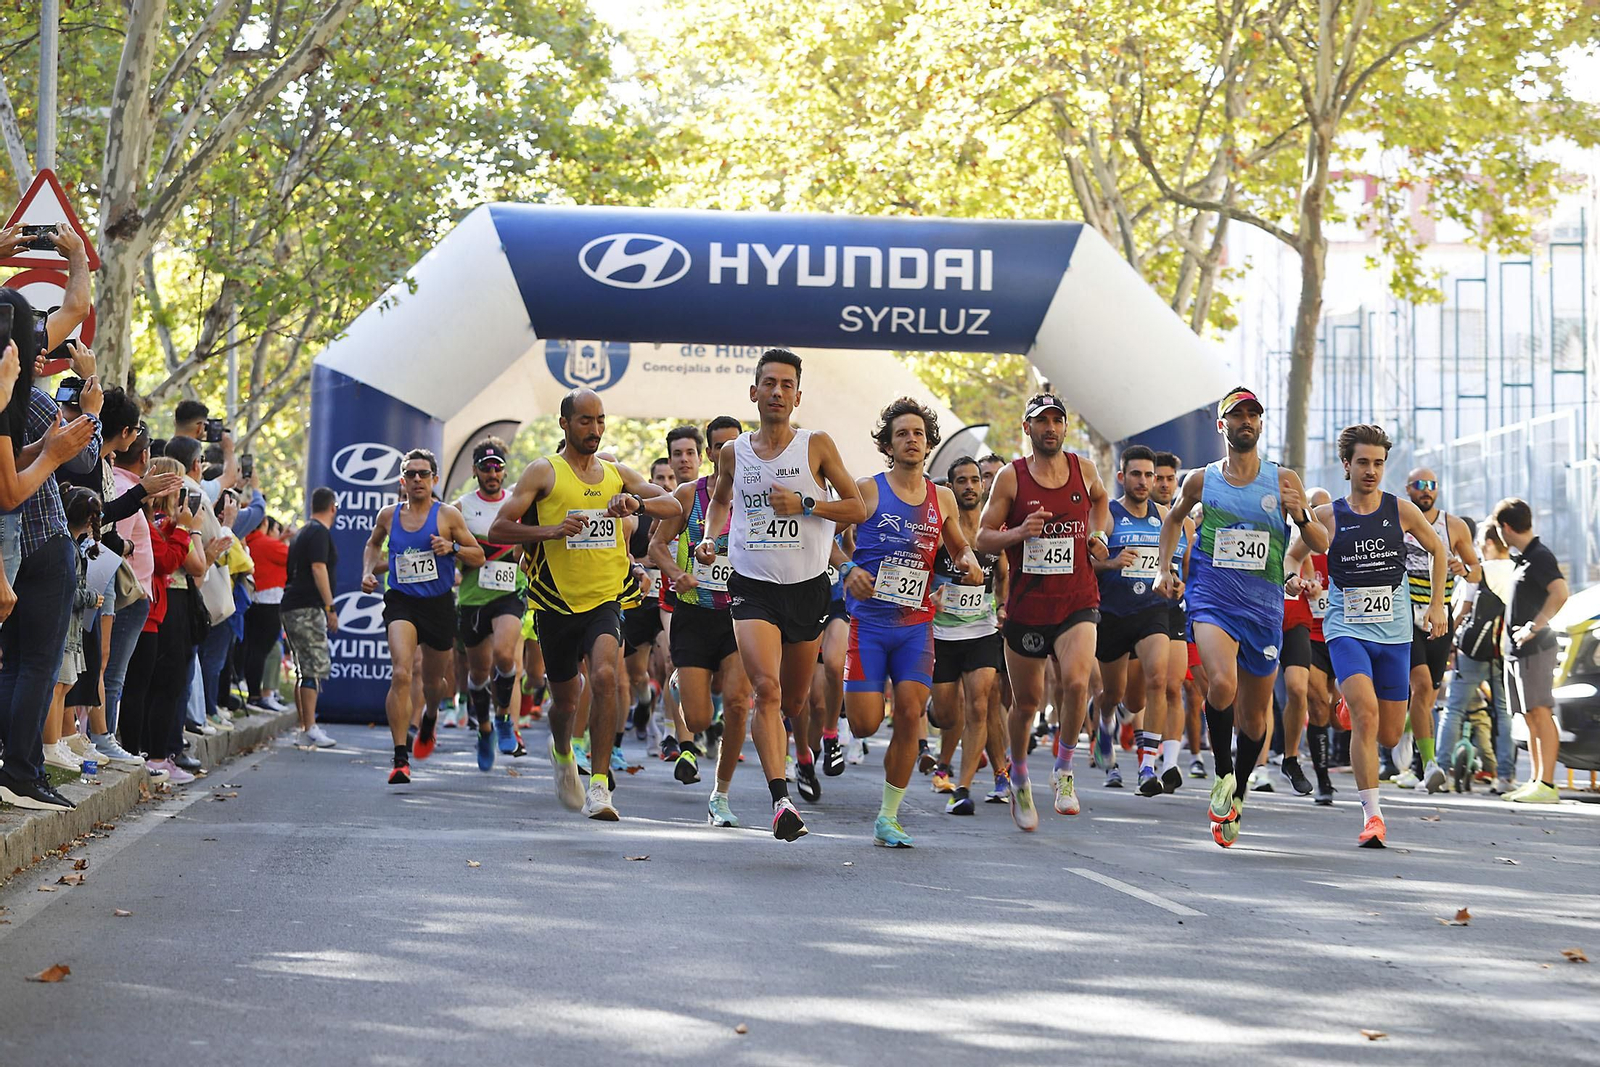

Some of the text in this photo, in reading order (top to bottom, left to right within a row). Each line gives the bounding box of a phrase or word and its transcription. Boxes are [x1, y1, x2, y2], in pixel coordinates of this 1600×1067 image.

[709, 242, 993, 291] HYUNDAI
[839, 305, 991, 335] SYRLUZ
[681, 344, 706, 357] de
[716, 364, 731, 373] de
[743, 476, 761, 484] TEAM
[334, 491, 399, 510] YUND
[335, 515, 377, 530] SYRL
[590, 519, 614, 537] 239
[766, 520, 799, 537] 470
[1044, 521, 1085, 534] COSTA
[1236, 541, 1266, 559] 340
[1354, 538, 1385, 553] HGC
[1043, 548, 1071, 563] 454
[1341, 554, 1368, 562] Huelva
[411, 559, 434, 574] 173
[712, 565, 734, 581] 66
[495, 570, 514, 582] 689
[897, 577, 923, 597] 321
[960, 594, 982, 607] 613
[1363, 596, 1390, 613] 240
[328, 639, 392, 659] YUND
[330, 663, 393, 680] SYRLUZ
